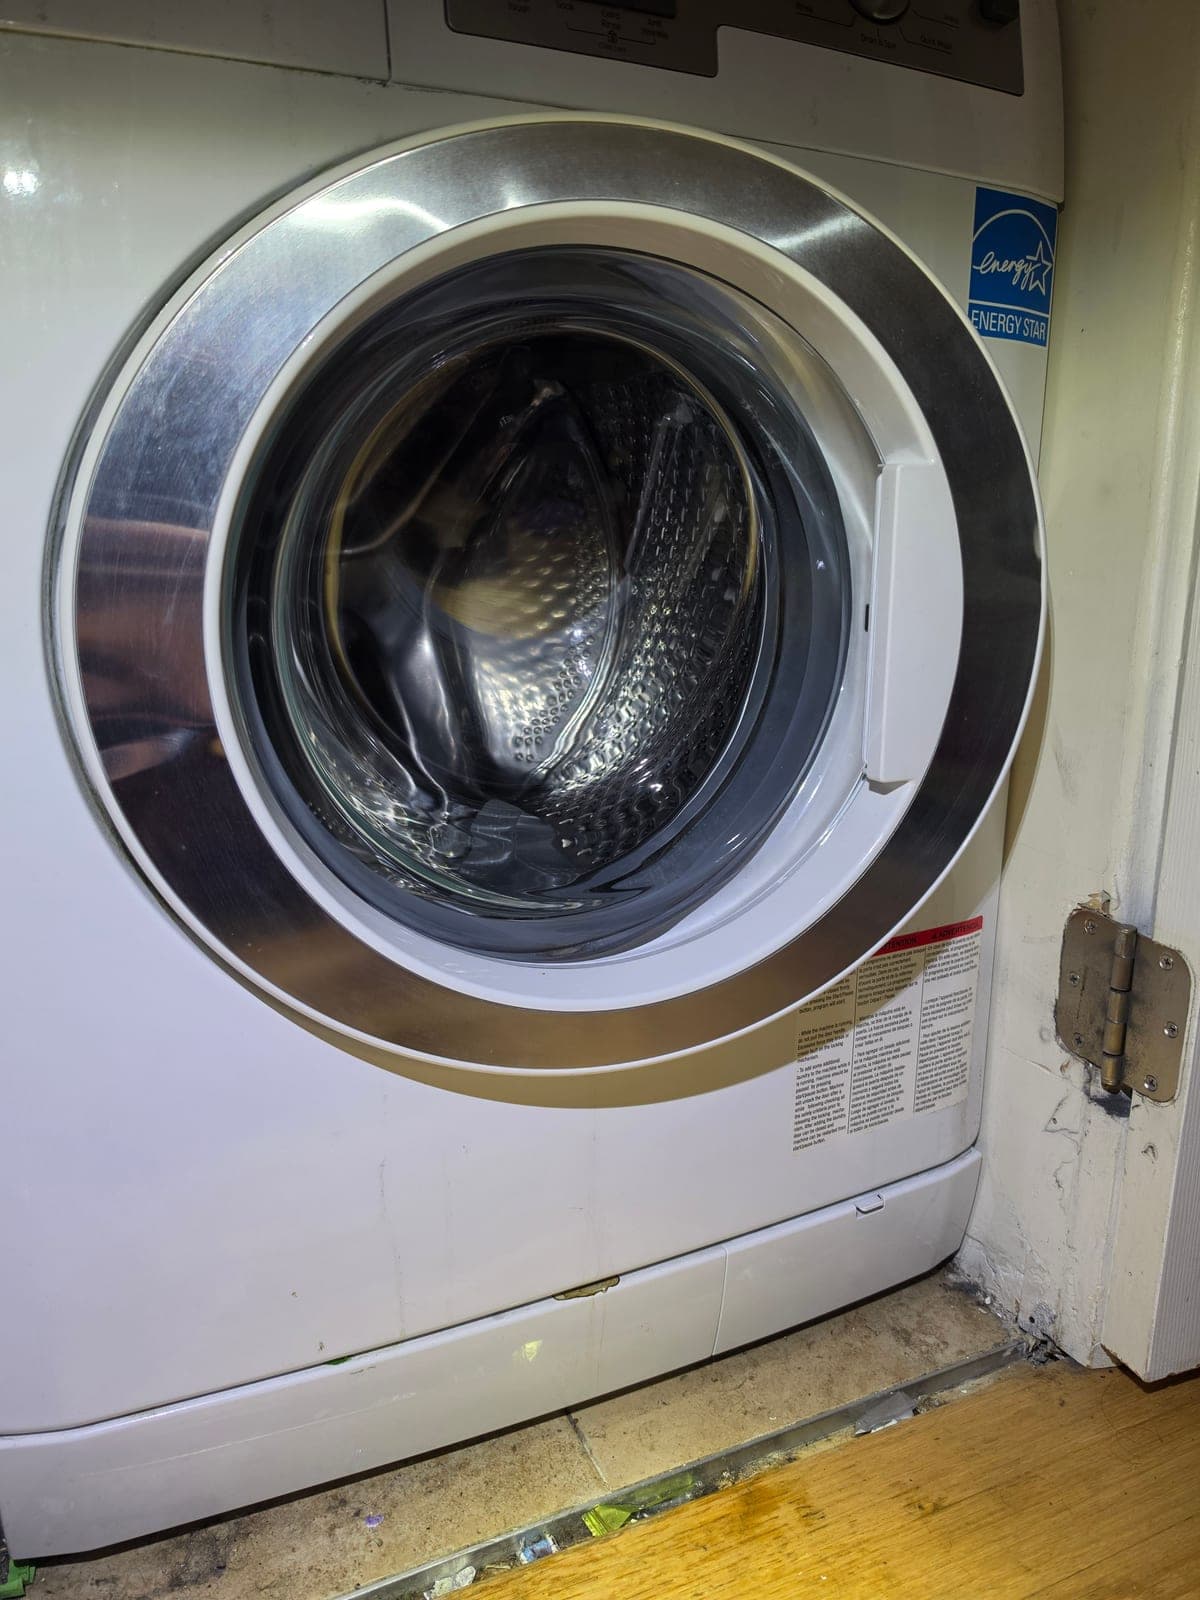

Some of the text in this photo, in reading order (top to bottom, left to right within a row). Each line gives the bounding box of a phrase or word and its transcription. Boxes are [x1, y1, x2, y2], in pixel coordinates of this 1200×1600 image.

[972, 251, 1041, 291] energy
[971, 310, 1046, 341] ENERGY STAR
